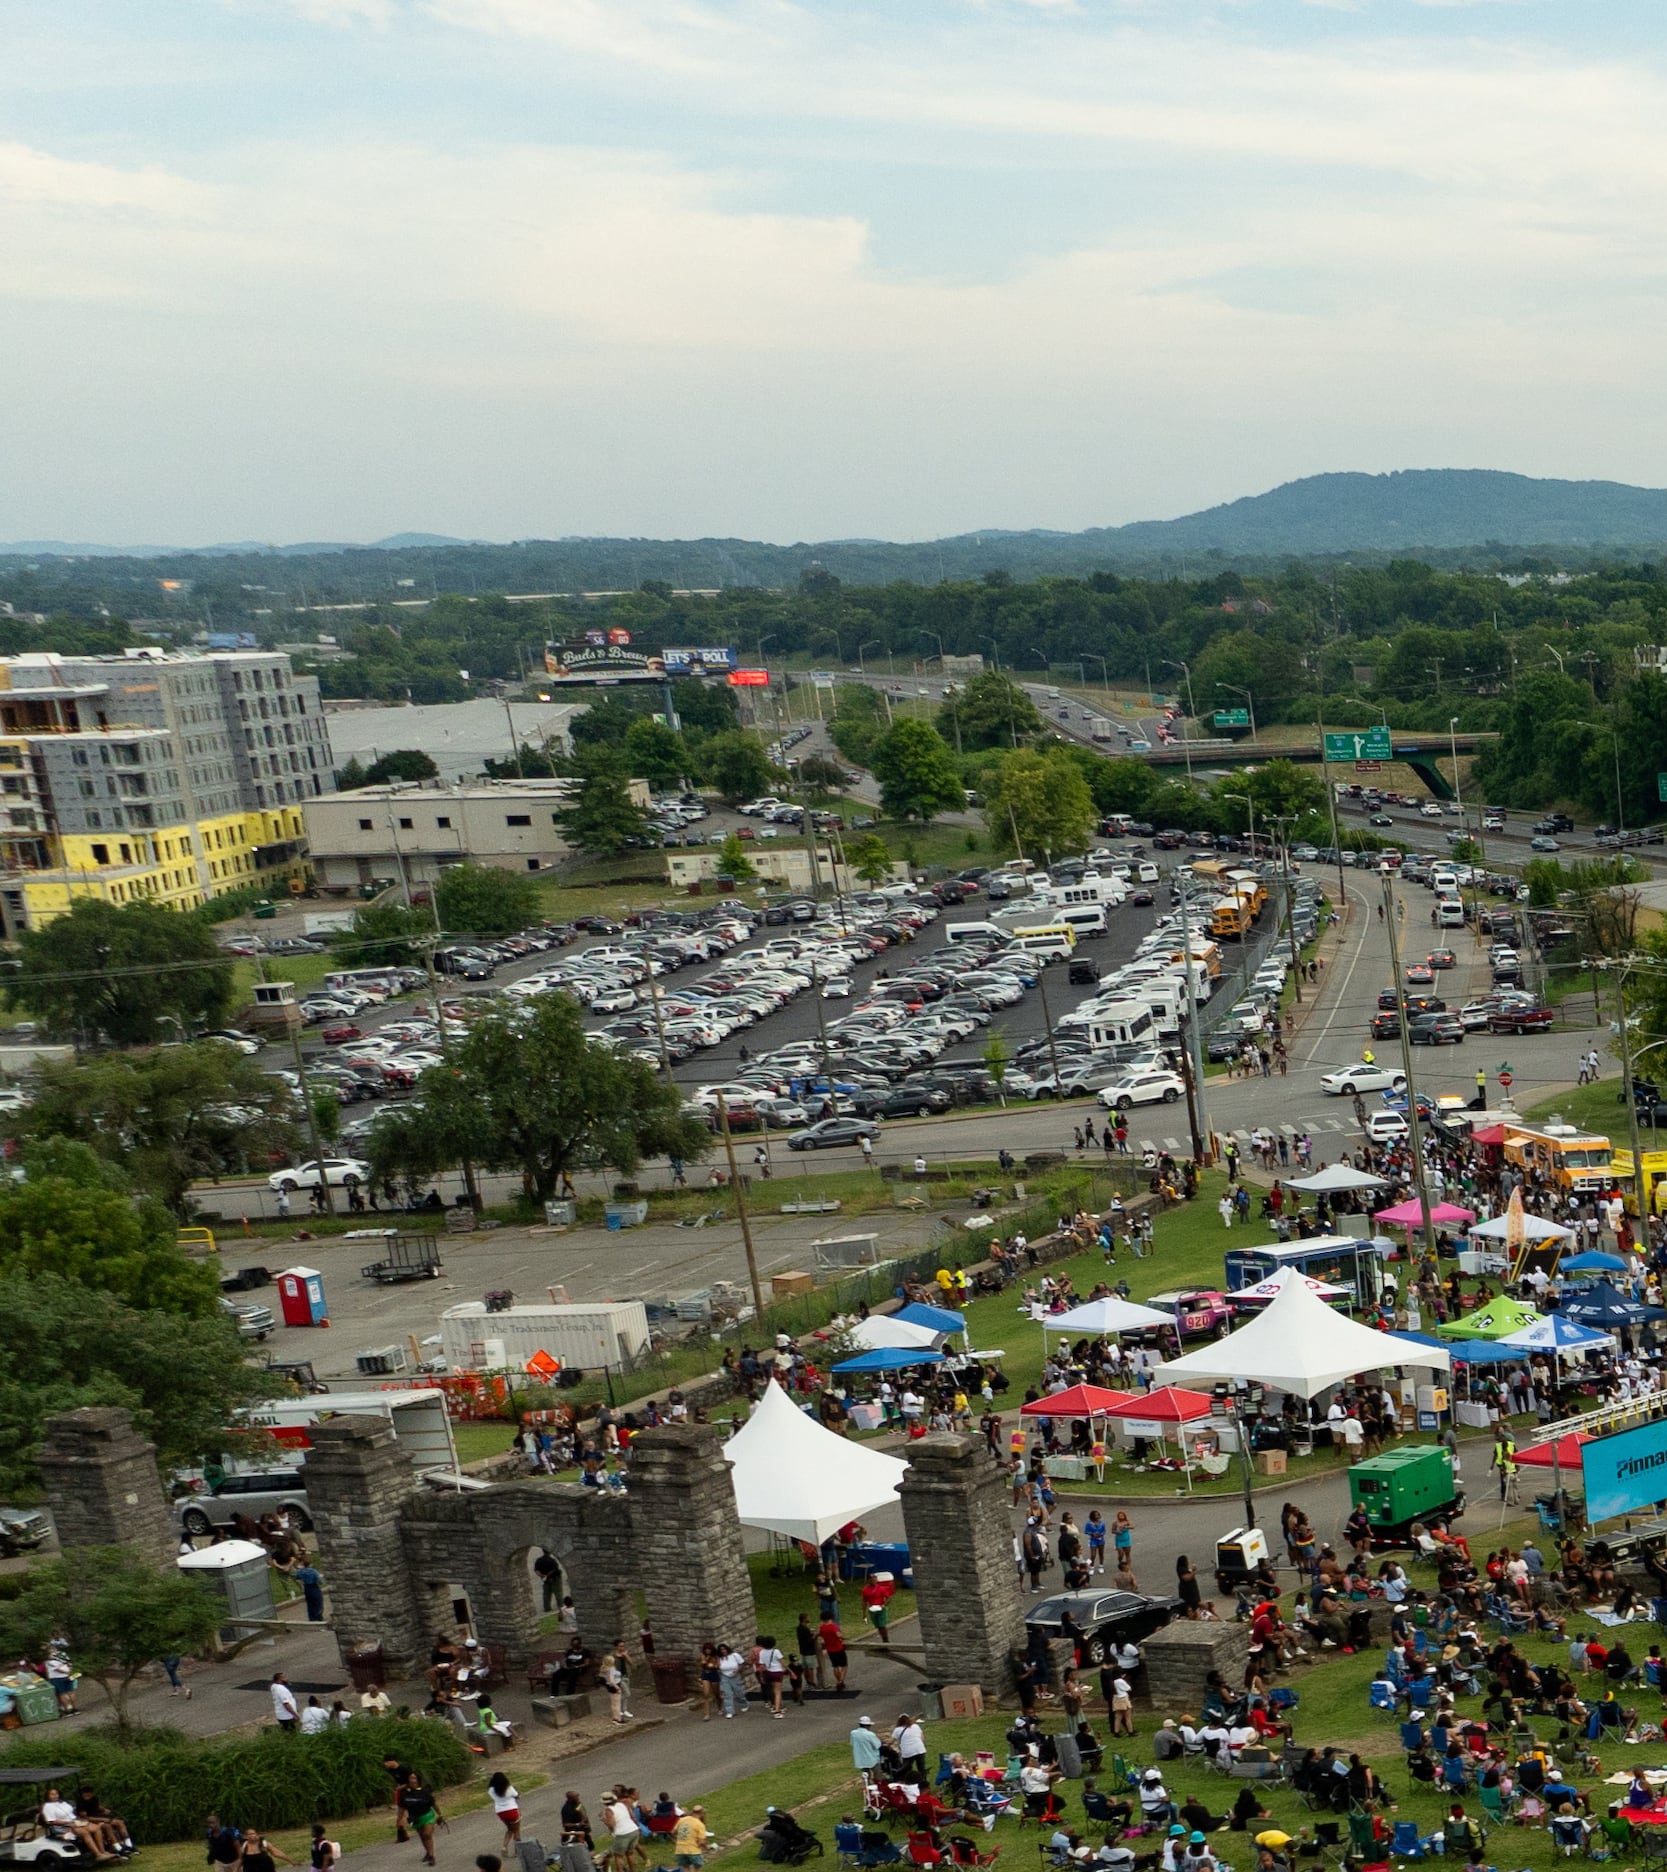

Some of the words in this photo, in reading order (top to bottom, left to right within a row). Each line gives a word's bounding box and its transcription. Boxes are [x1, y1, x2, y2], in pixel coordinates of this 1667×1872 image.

[563, 648, 596, 664] Buds
[608, 646, 648, 662] Brews
[703, 651, 730, 662] ROLL
[490, 1324, 505, 1334] The
[509, 1323, 560, 1334] Tradesmen
